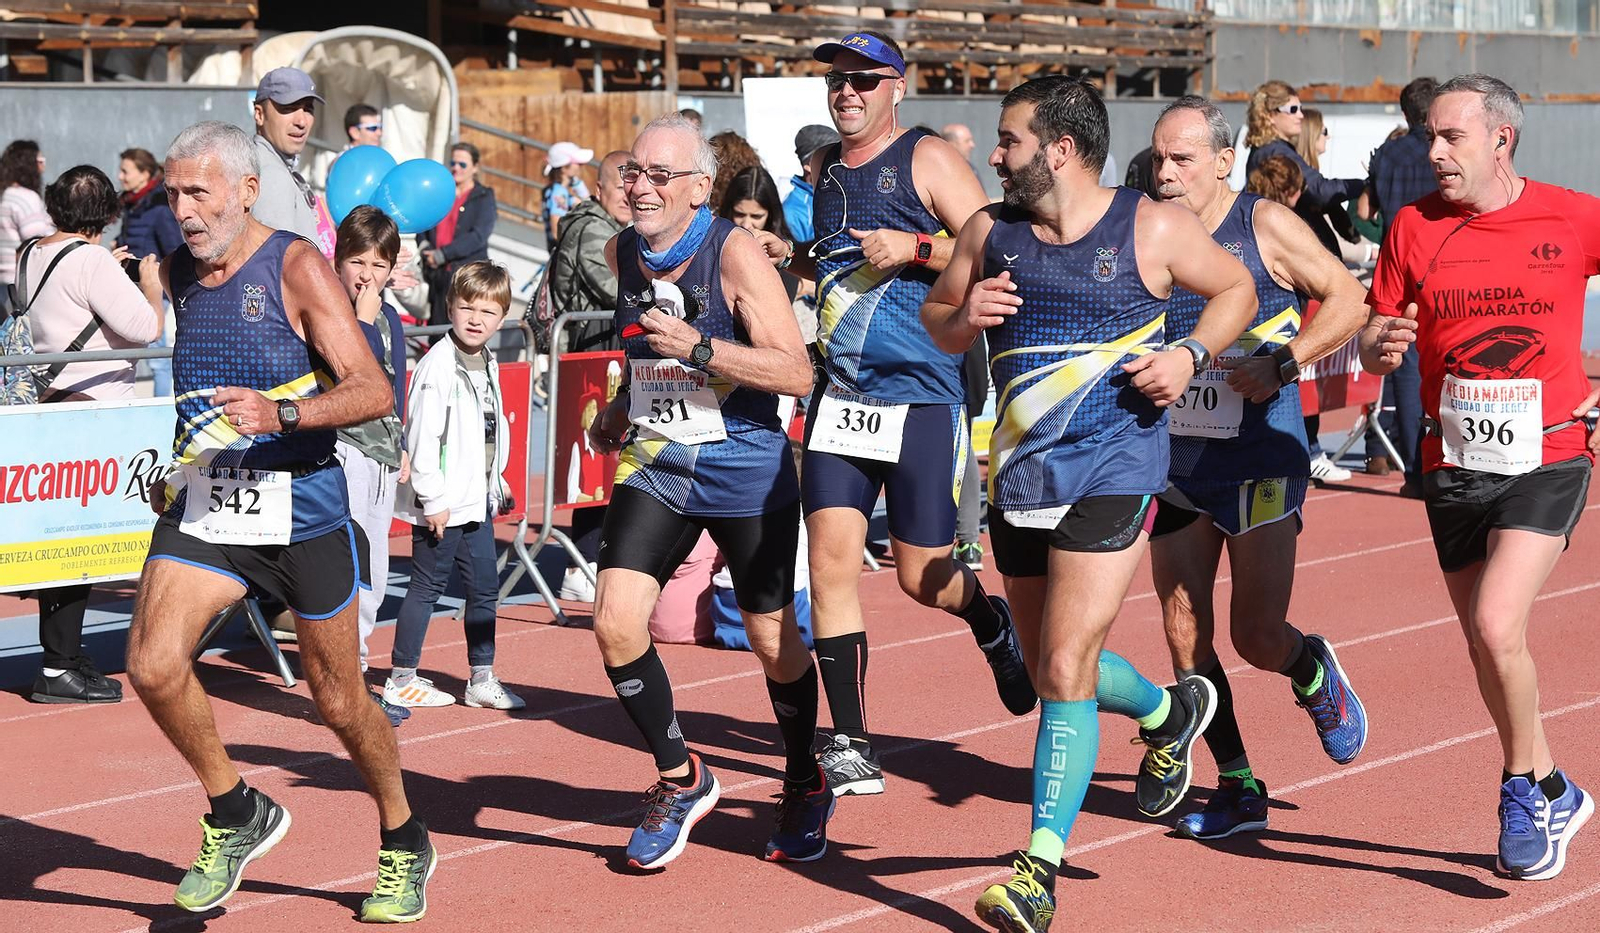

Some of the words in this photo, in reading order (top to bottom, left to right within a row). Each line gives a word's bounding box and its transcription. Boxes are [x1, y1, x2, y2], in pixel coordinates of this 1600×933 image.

[1527, 262, 1566, 270] Carrefour
[1433, 288, 1466, 320] XXIII
[1467, 287, 1524, 301] MEDIA
[1468, 299, 1554, 317] MARATÓN
[666, 382, 675, 392] DE
[649, 398, 692, 424] 531
[1450, 398, 1481, 413] CIUDAD
[1484, 402, 1496, 413] DE
[1500, 402, 1528, 413] JEREZ
[836, 407, 882, 434] 330
[1461, 416, 1514, 446] 396
[208, 485, 261, 515] 542
[35, 546, 90, 561] CRUZCAMPO
[91, 543, 109, 556] CON
[111, 541, 137, 554] ZUMO
[61, 558, 106, 570] DOBLEMENTE
